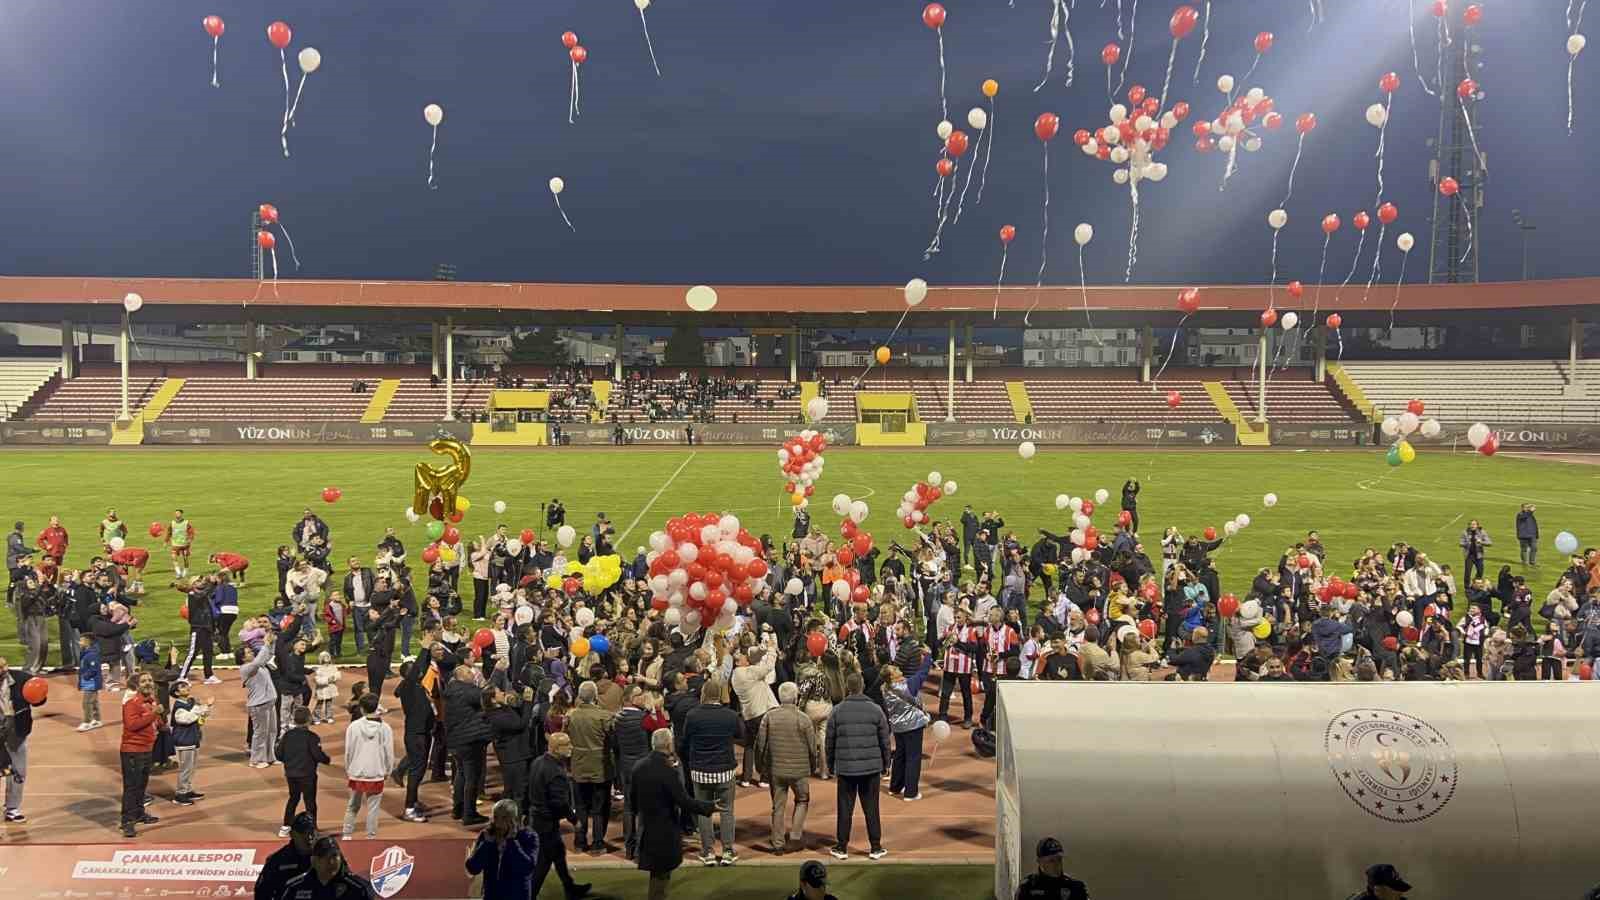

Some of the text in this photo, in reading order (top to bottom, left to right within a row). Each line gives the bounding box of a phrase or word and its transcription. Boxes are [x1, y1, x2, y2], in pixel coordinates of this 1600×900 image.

[238, 426, 264, 439] YÜZ
[624, 427, 651, 440] YÜZ
[992, 427, 1018, 440] YÜZ
[122, 853, 242, 865] ÇANAKKALESPOR
[81, 866, 138, 875] ÇANAKKALE
[186, 867, 226, 876] YENİDEN
